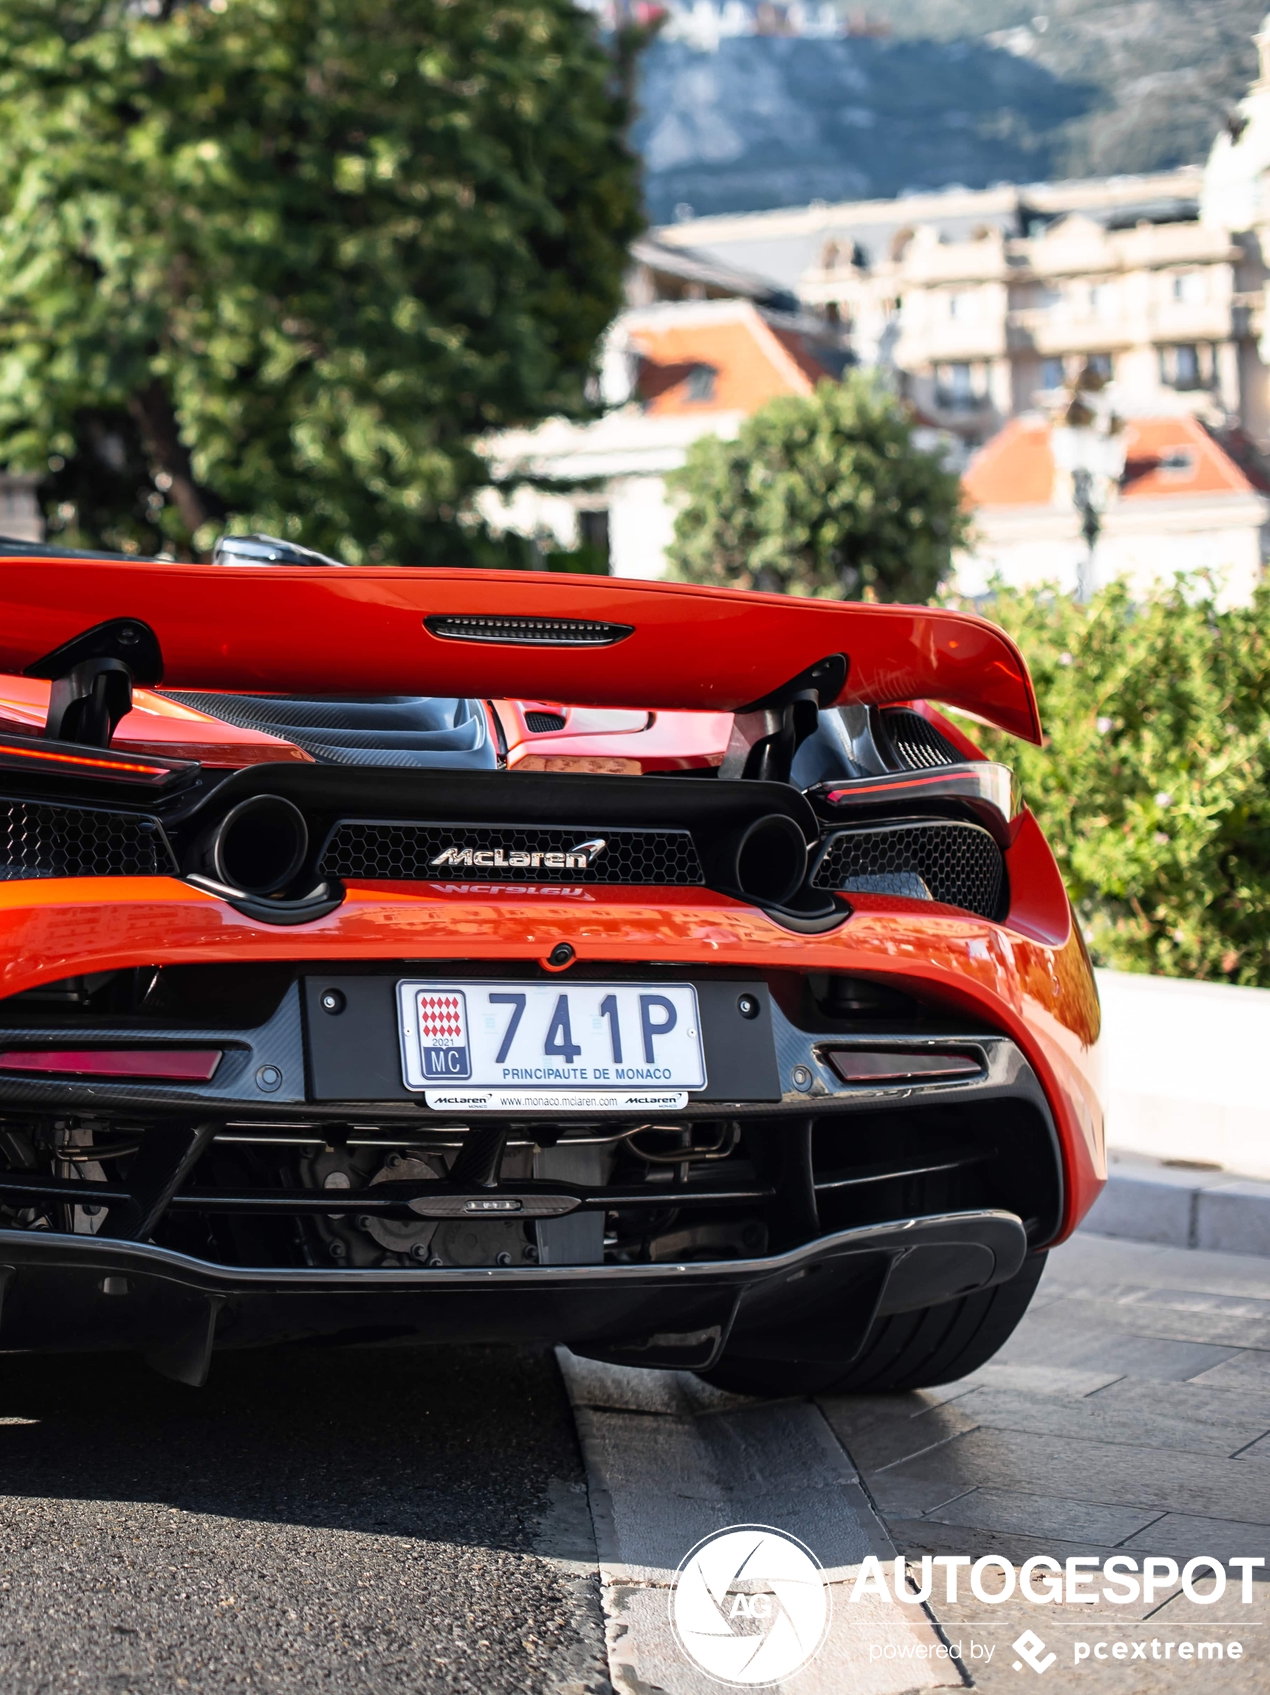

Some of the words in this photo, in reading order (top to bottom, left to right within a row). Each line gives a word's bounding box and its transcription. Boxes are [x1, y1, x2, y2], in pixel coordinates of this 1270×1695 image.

[432, 845, 589, 868] McLaren
[488, 993, 678, 1065] 741P
[432, 1038, 455, 1047] 2021
[431, 1051, 460, 1073] MC
[502, 1068, 587, 1079] PRINCIPAUTE
[593, 1069, 610, 1080] DE
[616, 1069, 672, 1080] MONACO
[434, 1095, 488, 1104] McLaren
[500, 1096, 618, 1107] www.monaco.mclaren.com
[625, 1095, 678, 1104] McLaren
